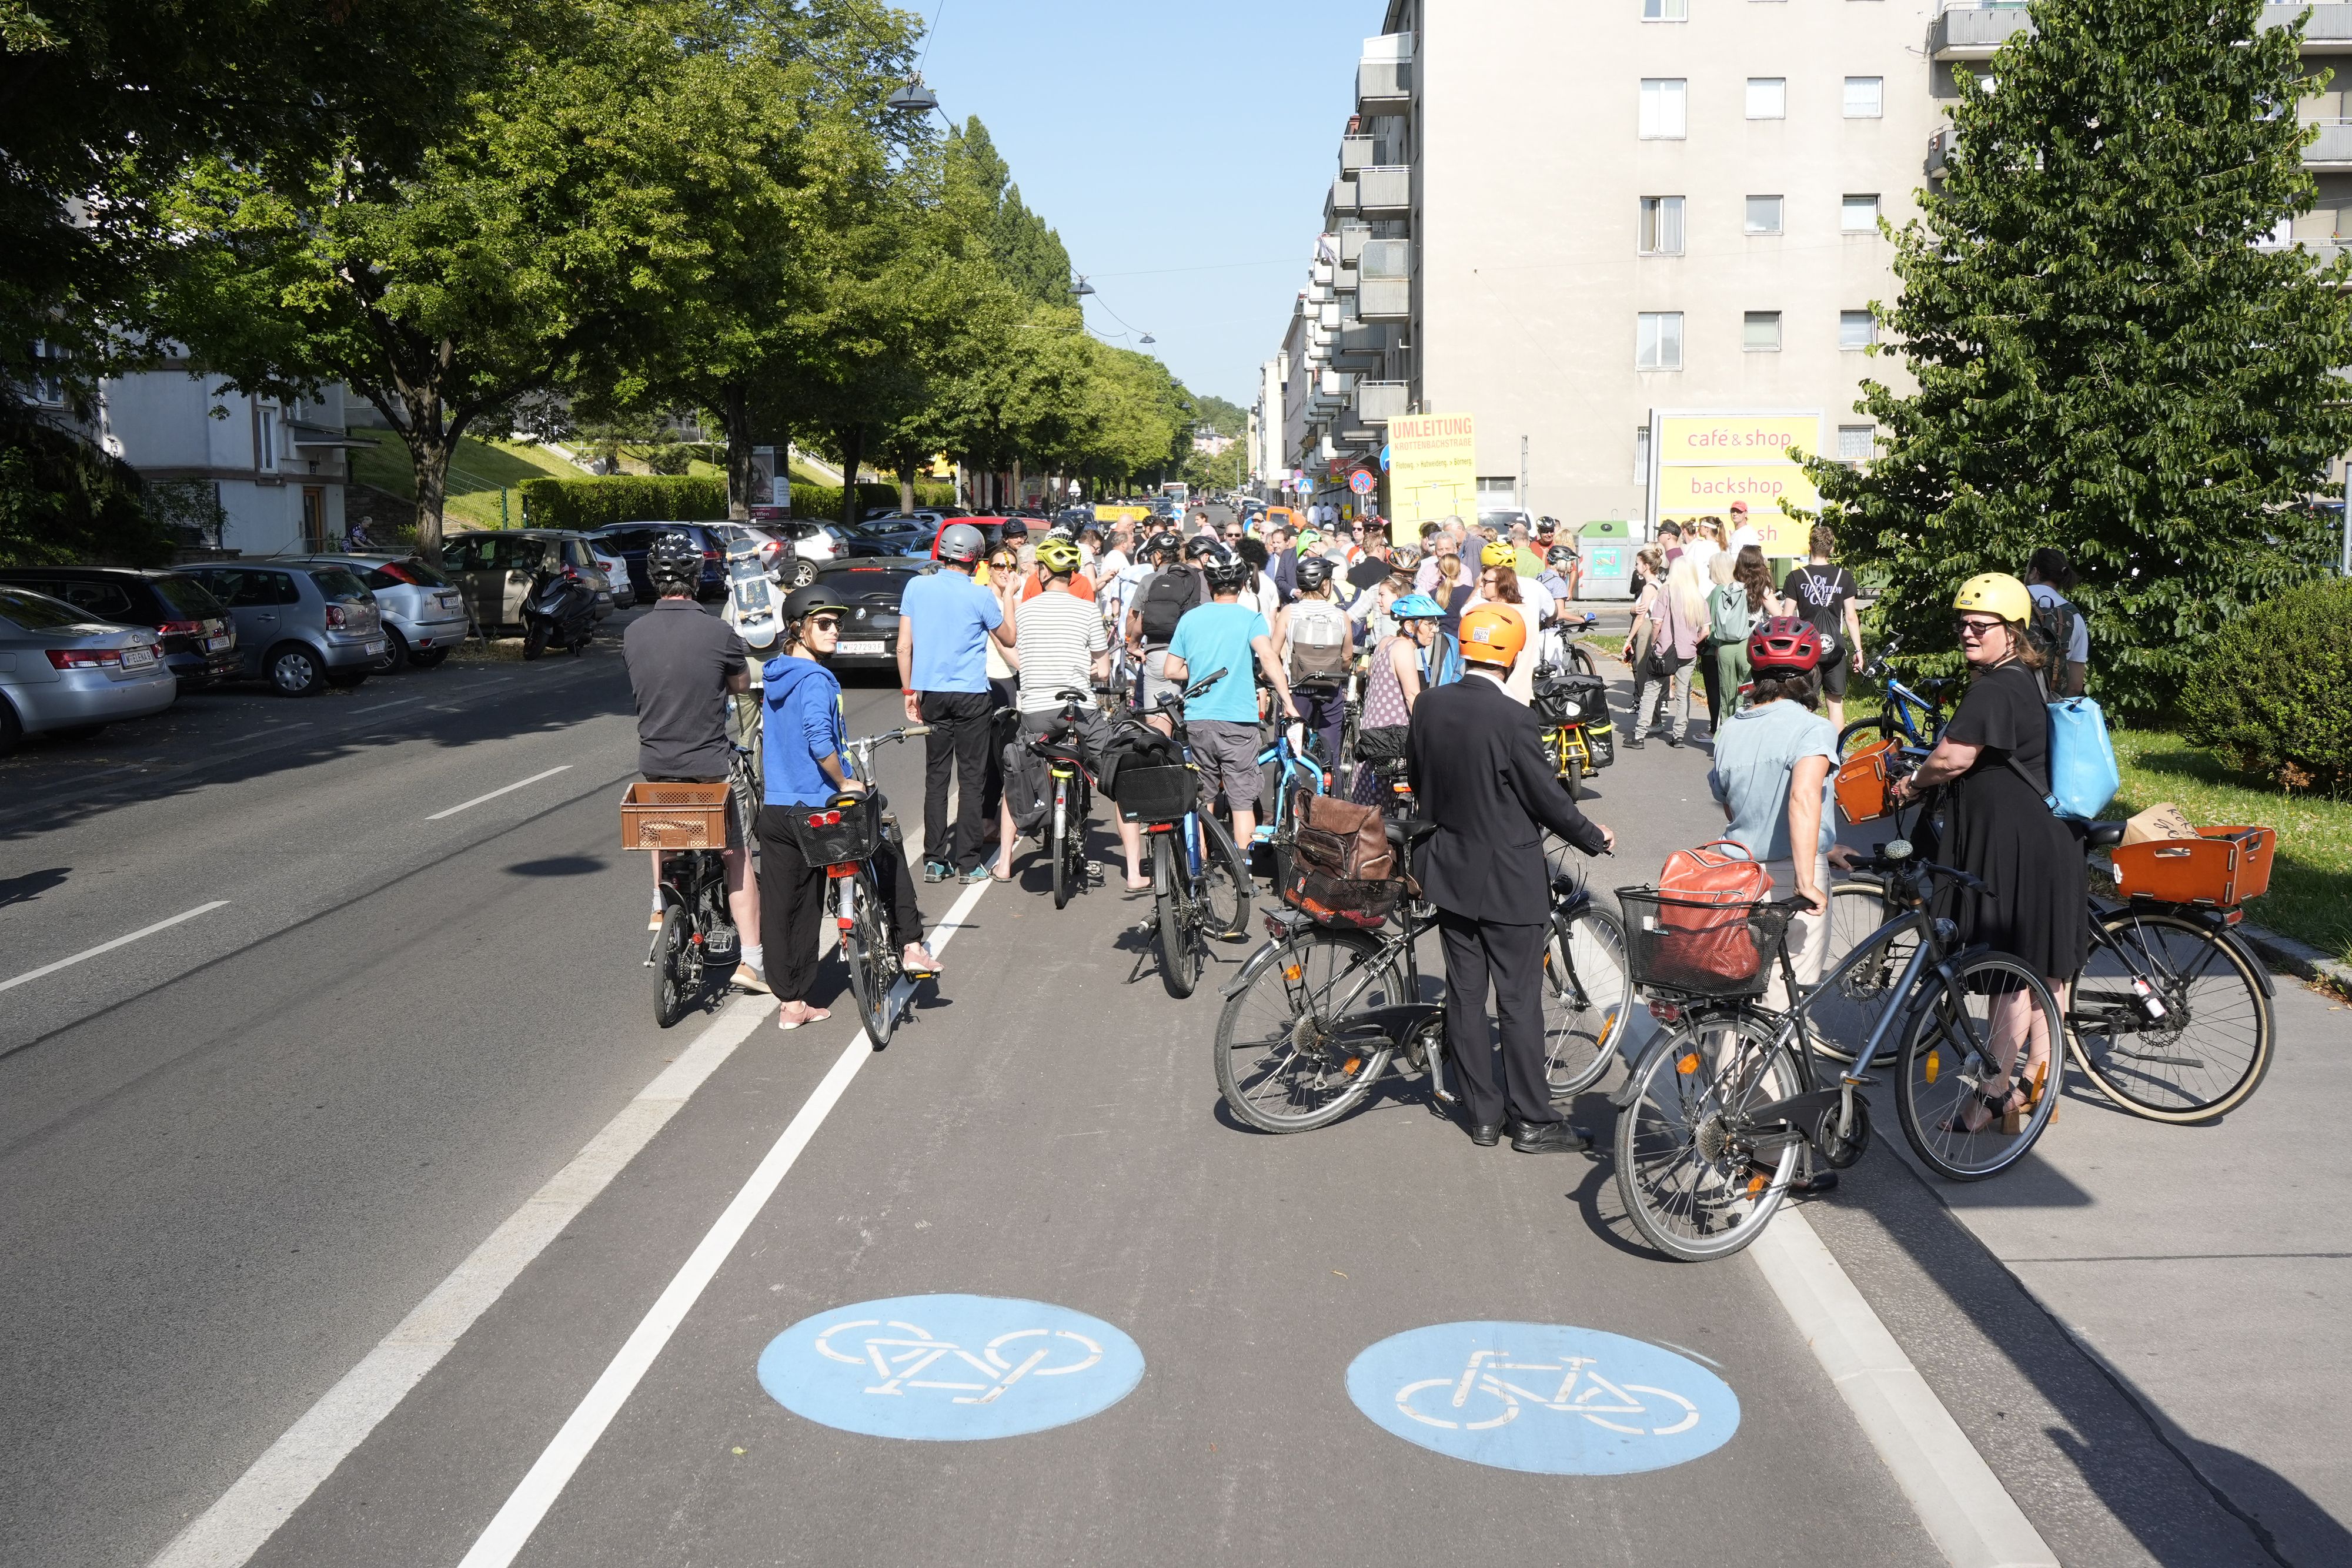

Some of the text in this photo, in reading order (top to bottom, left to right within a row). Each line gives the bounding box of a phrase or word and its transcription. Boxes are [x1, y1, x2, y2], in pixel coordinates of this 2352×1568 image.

[1393, 417, 1472, 439] UMLEITUNG
[1688, 429, 1728, 446] café
[1746, 429, 1790, 450] shop
[1692, 477, 1782, 497] backshop
